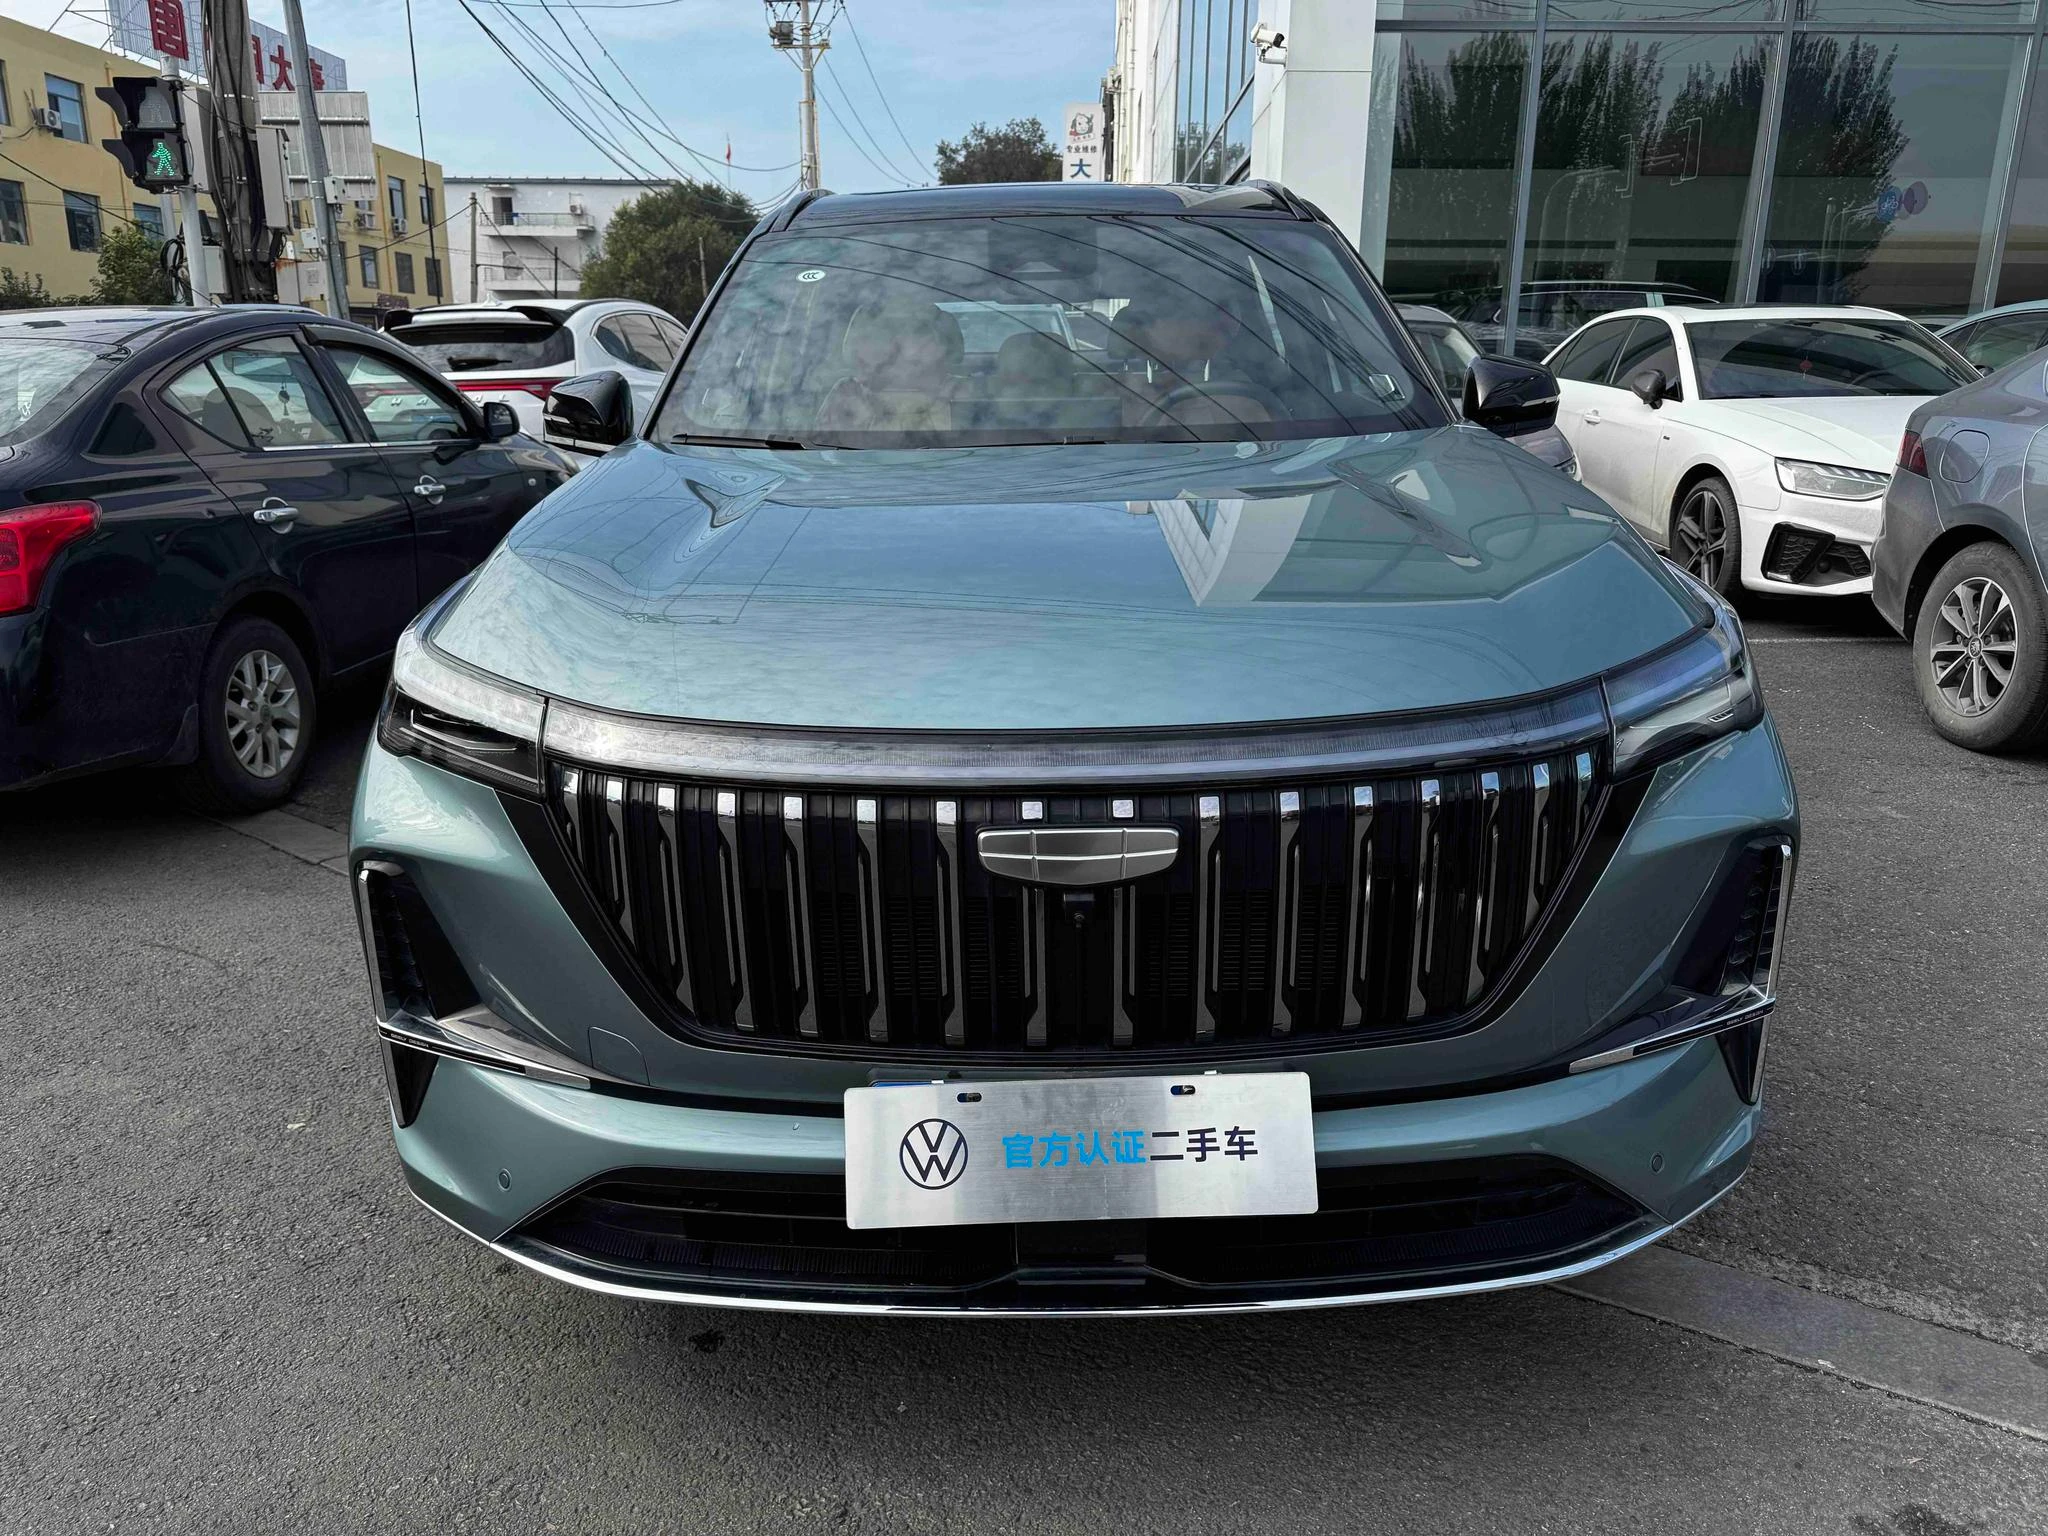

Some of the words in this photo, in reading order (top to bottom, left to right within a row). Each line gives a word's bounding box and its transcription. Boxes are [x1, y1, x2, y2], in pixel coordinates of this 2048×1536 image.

[1070, 158, 1092, 179] 大
[1001, 1125, 1260, 1169] 官方认证二手车
